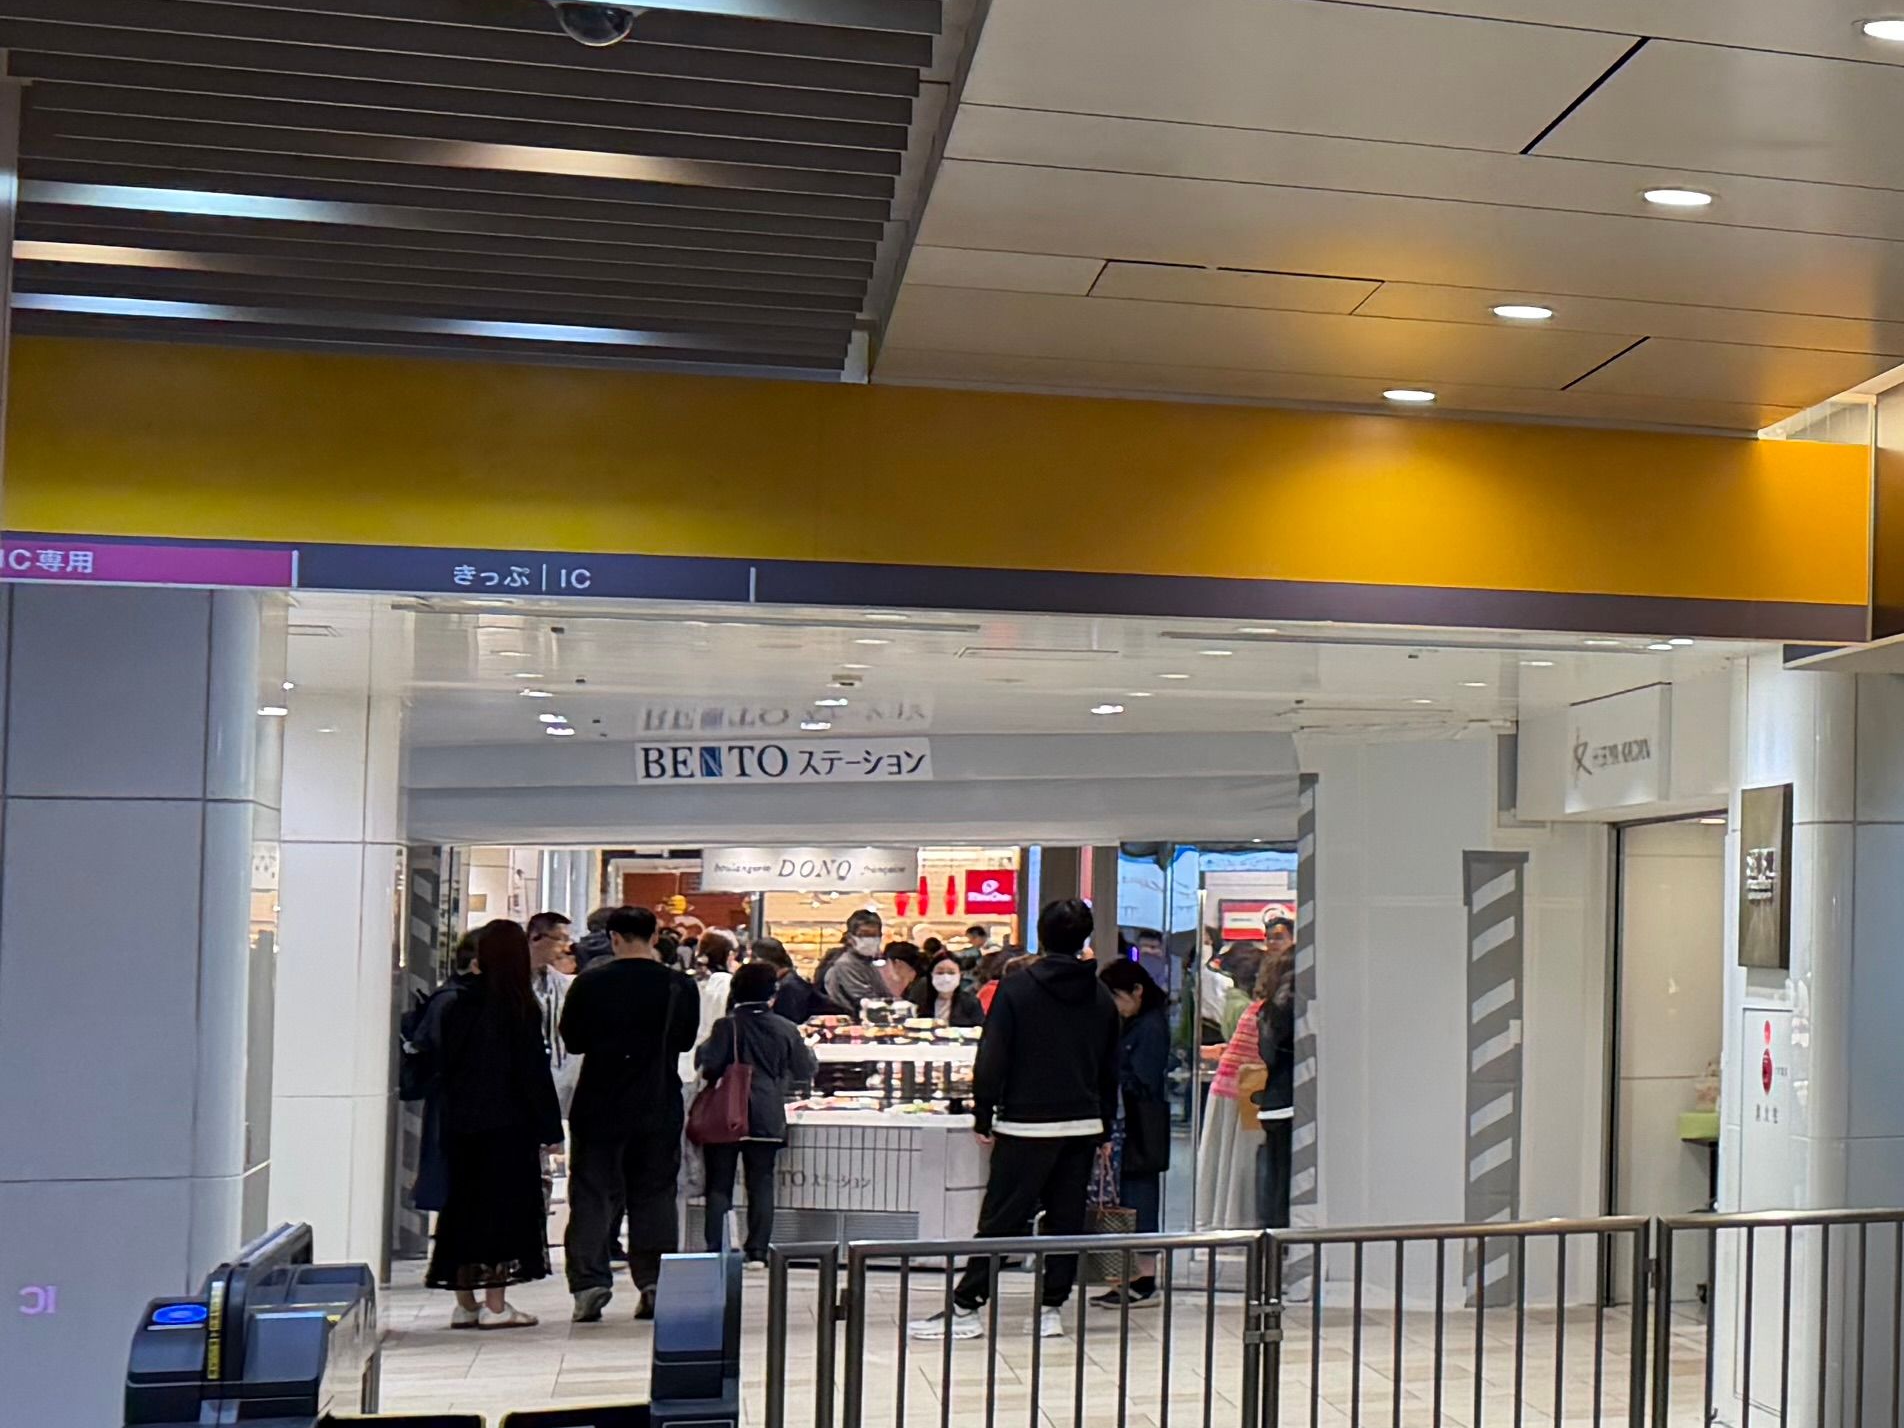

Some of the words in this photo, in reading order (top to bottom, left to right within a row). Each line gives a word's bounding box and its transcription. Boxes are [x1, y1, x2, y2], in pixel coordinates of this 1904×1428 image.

[453, 565, 530, 587] きっぷ
[560, 568, 592, 589] IC
[640, 744, 789, 779] BENTO
[798, 749, 927, 776] ステーション
[777, 859, 853, 880] DONQ
